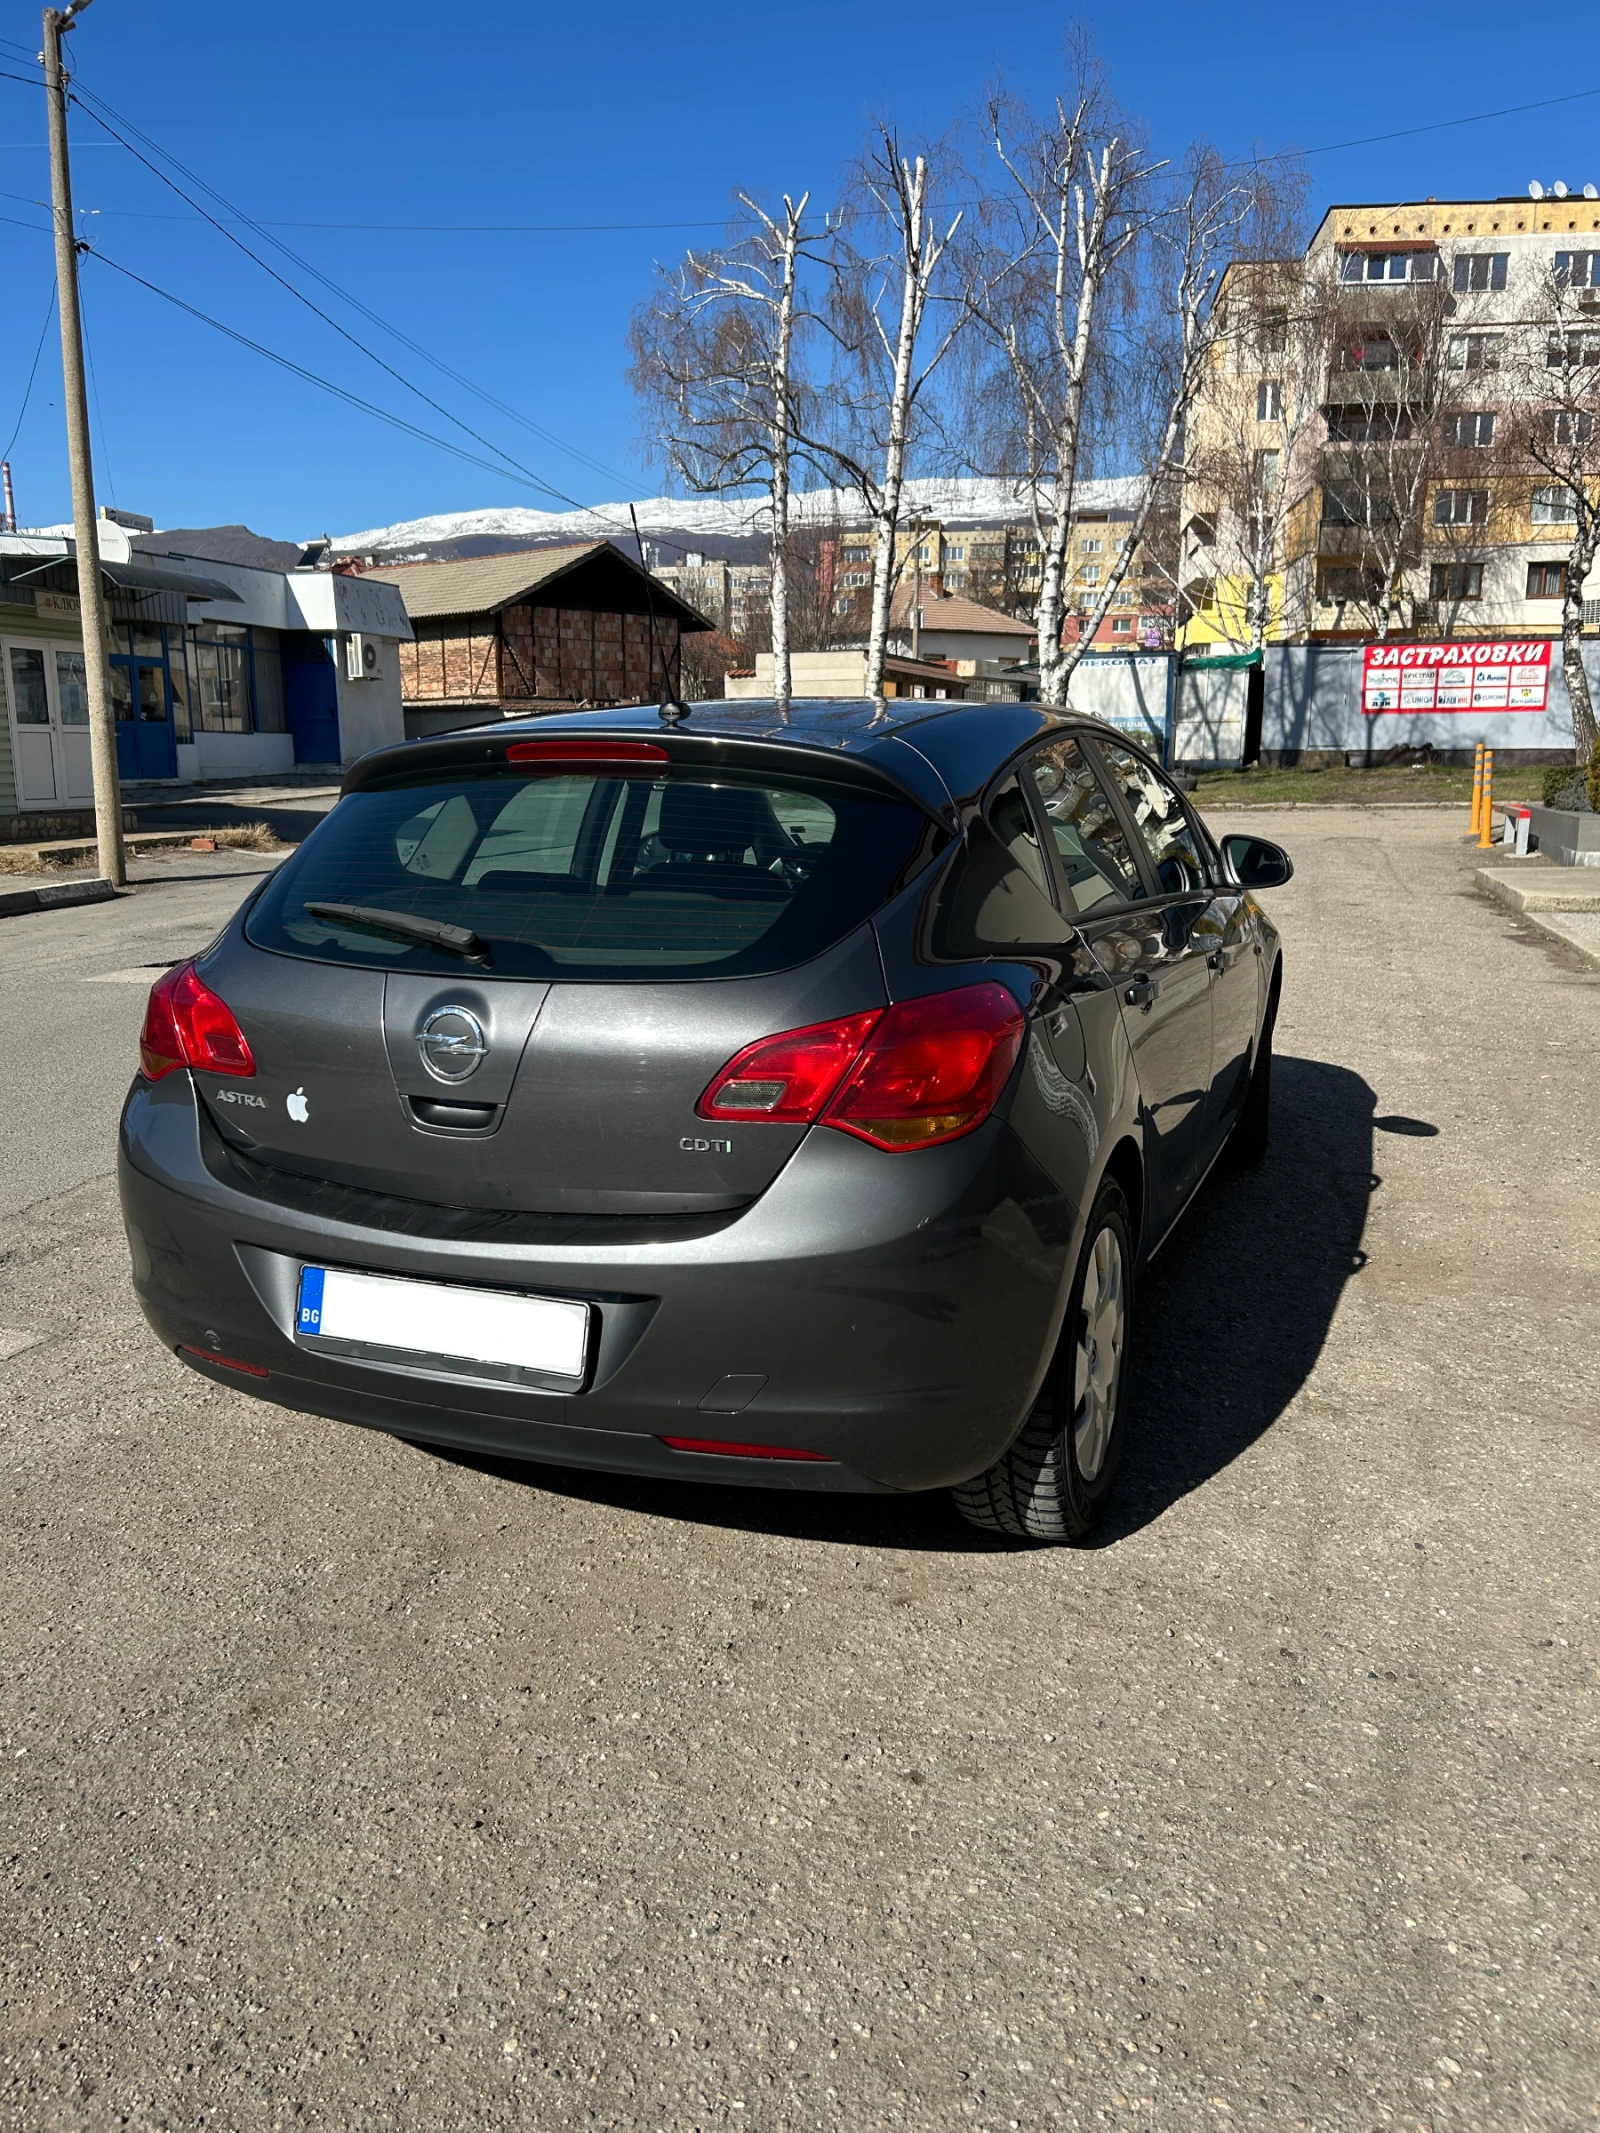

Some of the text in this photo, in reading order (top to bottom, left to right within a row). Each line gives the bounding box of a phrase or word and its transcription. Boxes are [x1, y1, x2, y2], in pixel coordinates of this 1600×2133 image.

[52, 596, 81, 612] КЛЮЧ
[1079, 658, 1159, 667] ЛЕКОМАТ
[1369, 643, 1546, 666] ЗАСТРАХОВКИ
[1411, 696, 1433, 704] UNIQA
[216, 1089, 267, 1109] ASTRA
[679, 1137, 732, 1153] CDTI
[301, 1308, 320, 1324] BG
